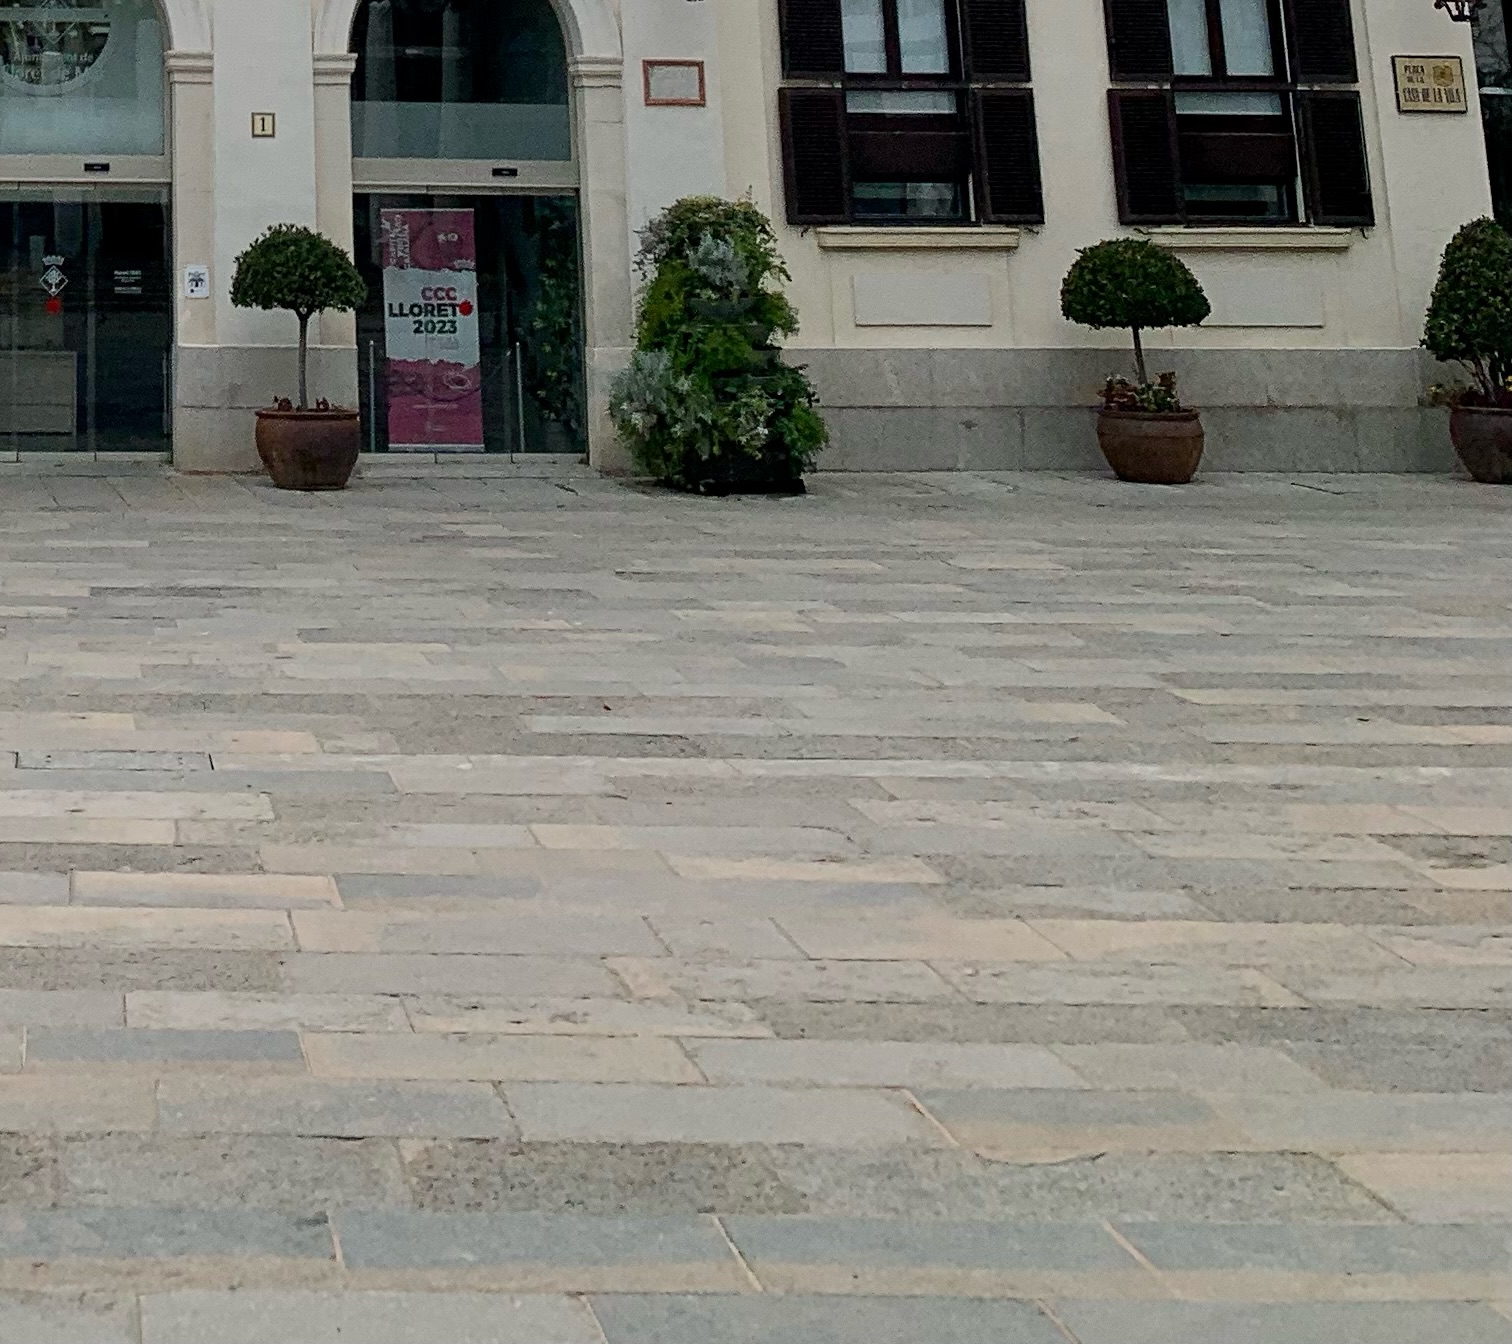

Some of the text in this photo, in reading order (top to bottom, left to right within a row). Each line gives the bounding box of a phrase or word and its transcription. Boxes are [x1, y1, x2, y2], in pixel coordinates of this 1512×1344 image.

[260, 116, 266, 132] 1
[421, 286, 458, 301] CCC
[388, 302, 459, 318] LLORET
[413, 319, 458, 334] 2023
